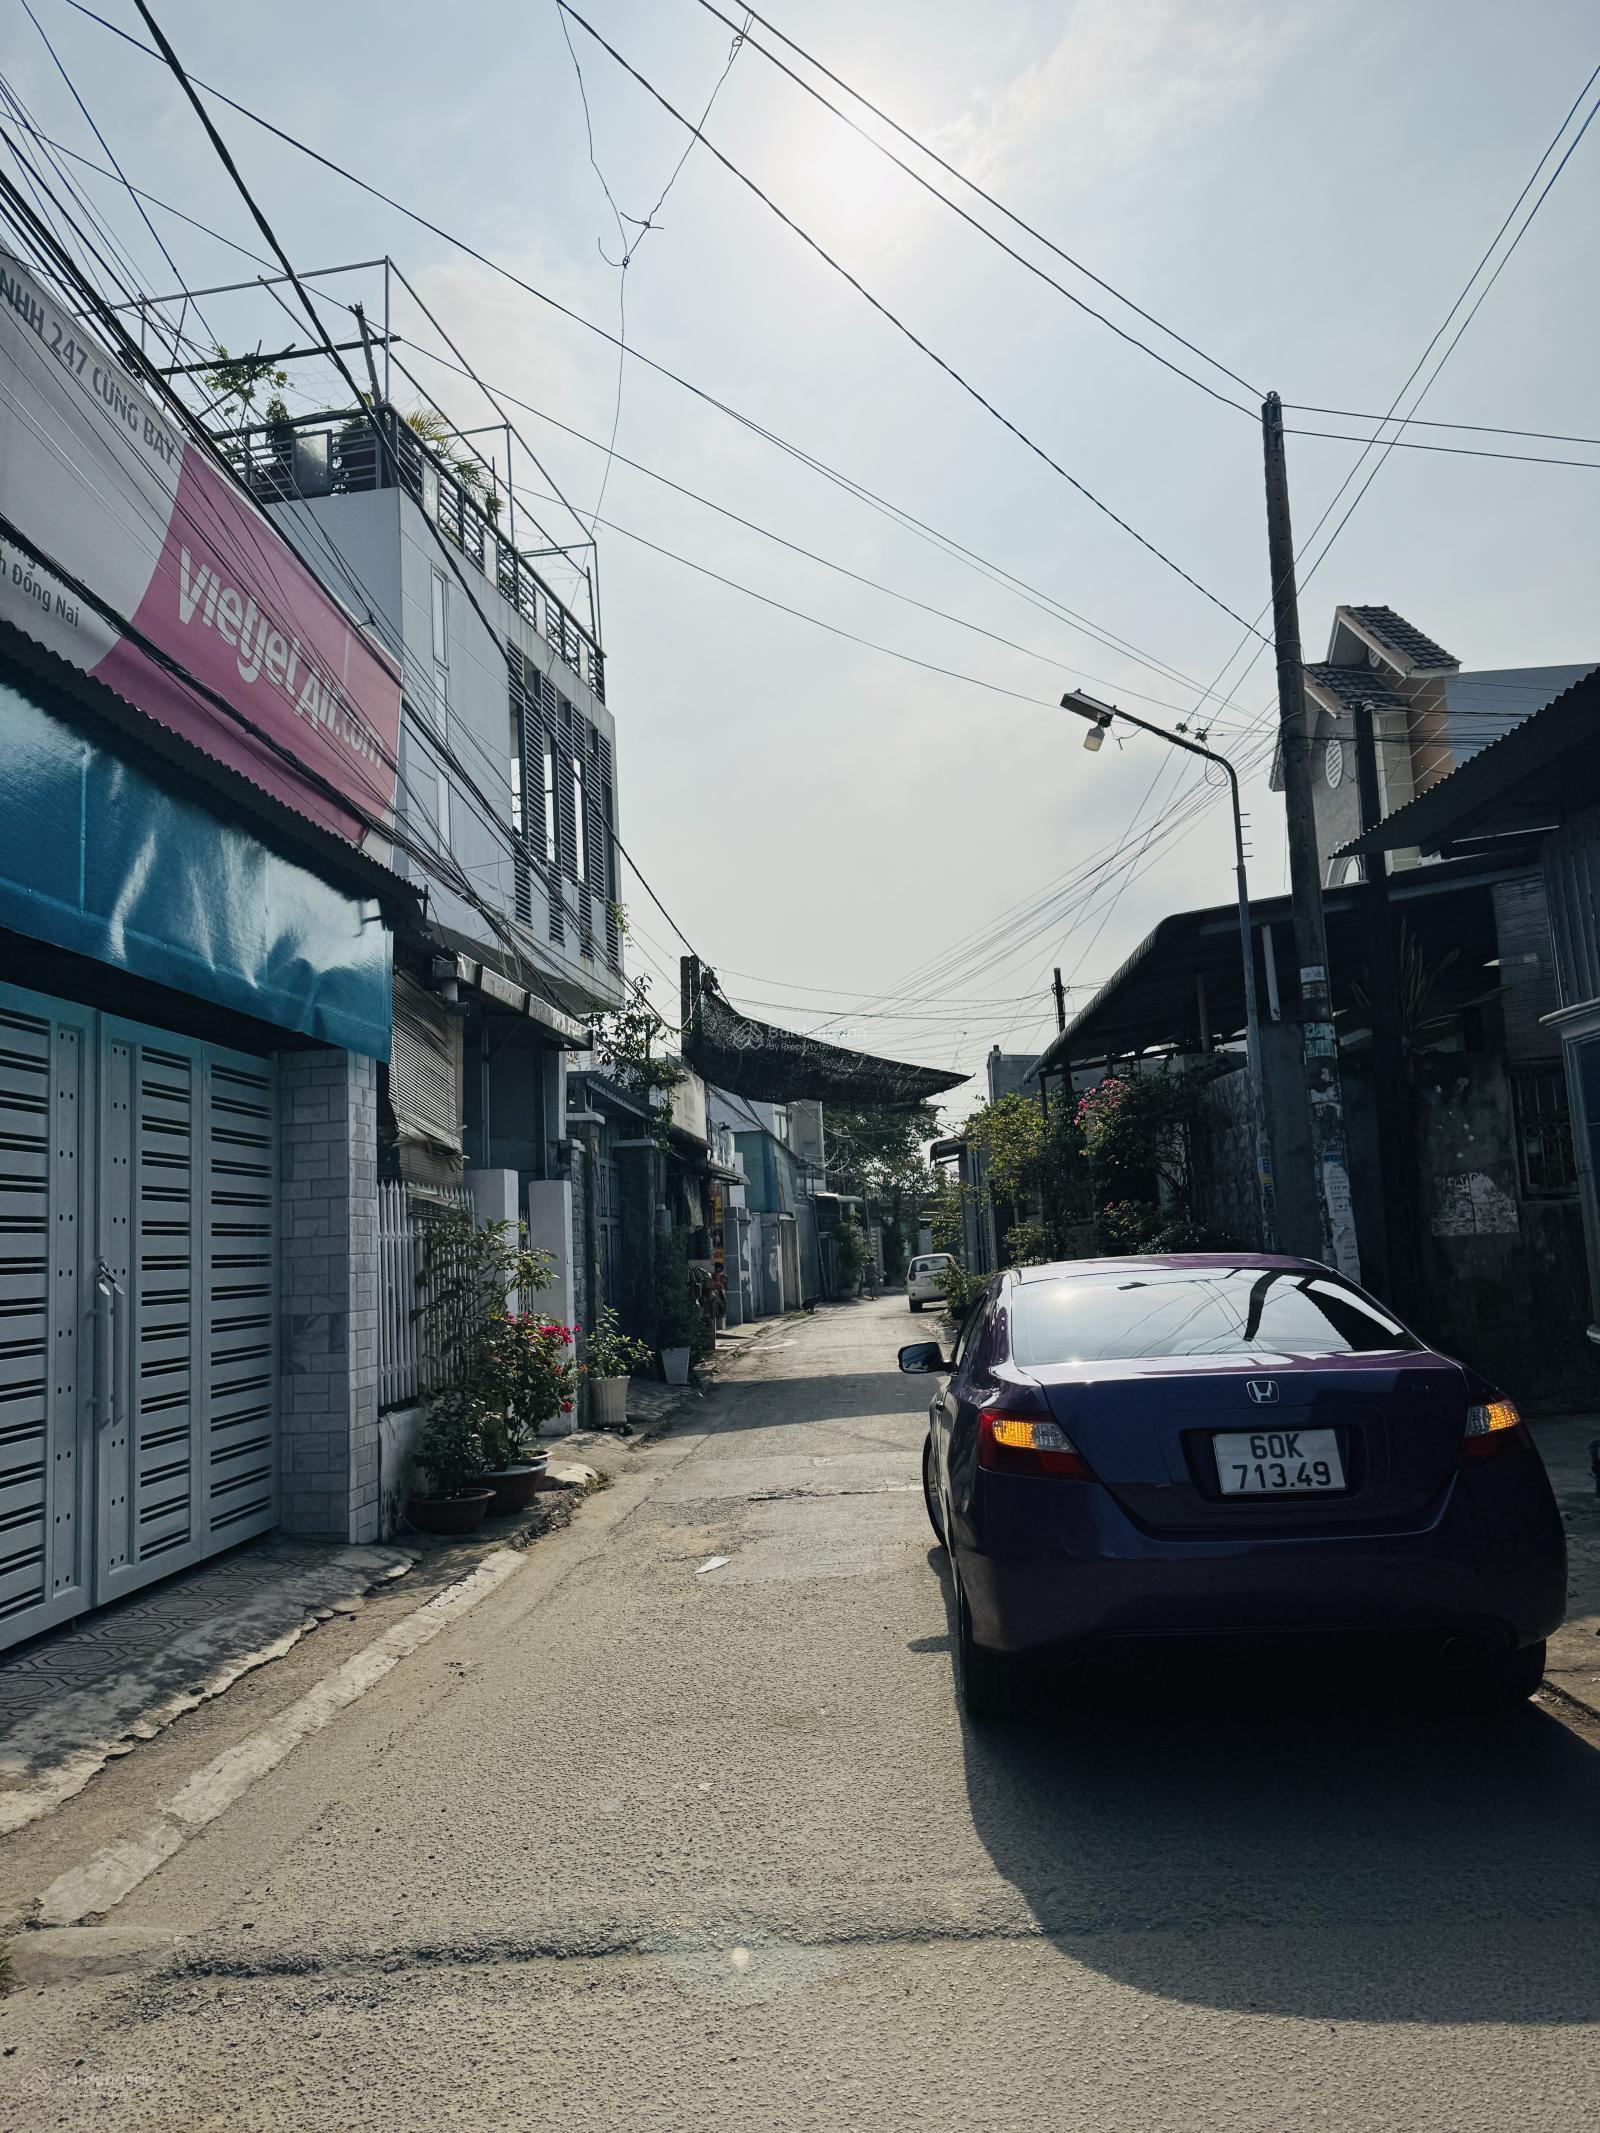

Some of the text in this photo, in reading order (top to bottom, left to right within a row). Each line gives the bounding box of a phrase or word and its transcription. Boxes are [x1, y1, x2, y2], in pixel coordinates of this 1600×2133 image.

[50, 321, 88, 377] 247
[92, 370, 140, 432] CÙNG
[143, 416, 175, 466] BAY
[12, 564, 51, 612] Đồng
[56, 595, 80, 627] Nai
[1249, 1433, 1304, 1459] 60K
[1232, 1461, 1332, 1489] 713.49
